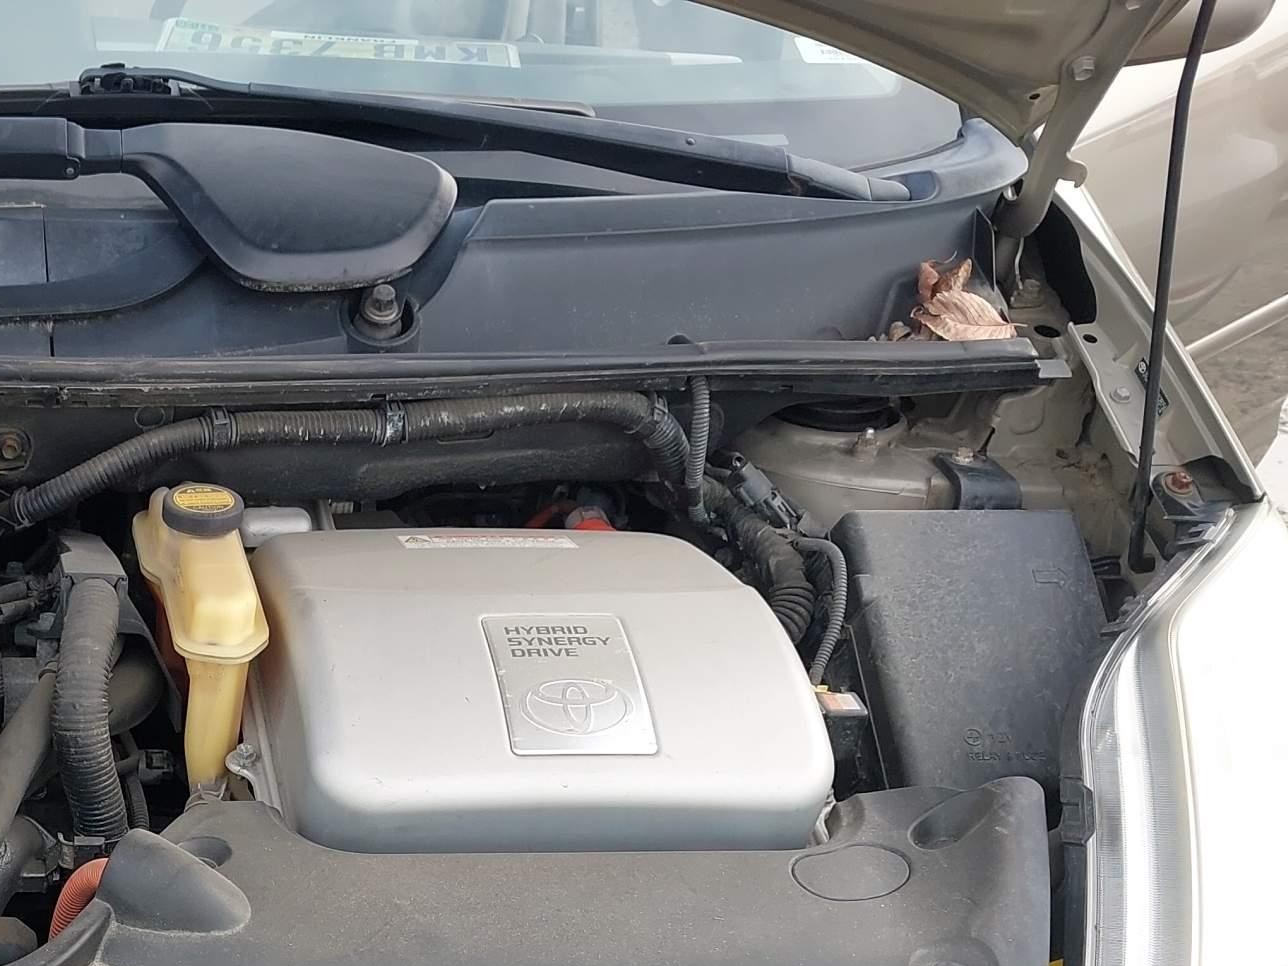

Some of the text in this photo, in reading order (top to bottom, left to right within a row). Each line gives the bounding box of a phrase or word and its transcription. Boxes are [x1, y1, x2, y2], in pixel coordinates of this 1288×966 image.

[503, 625, 588, 635] HYBRID
[507, 636, 610, 646] SYNERGY
[511, 647, 579, 657] DRIVE
